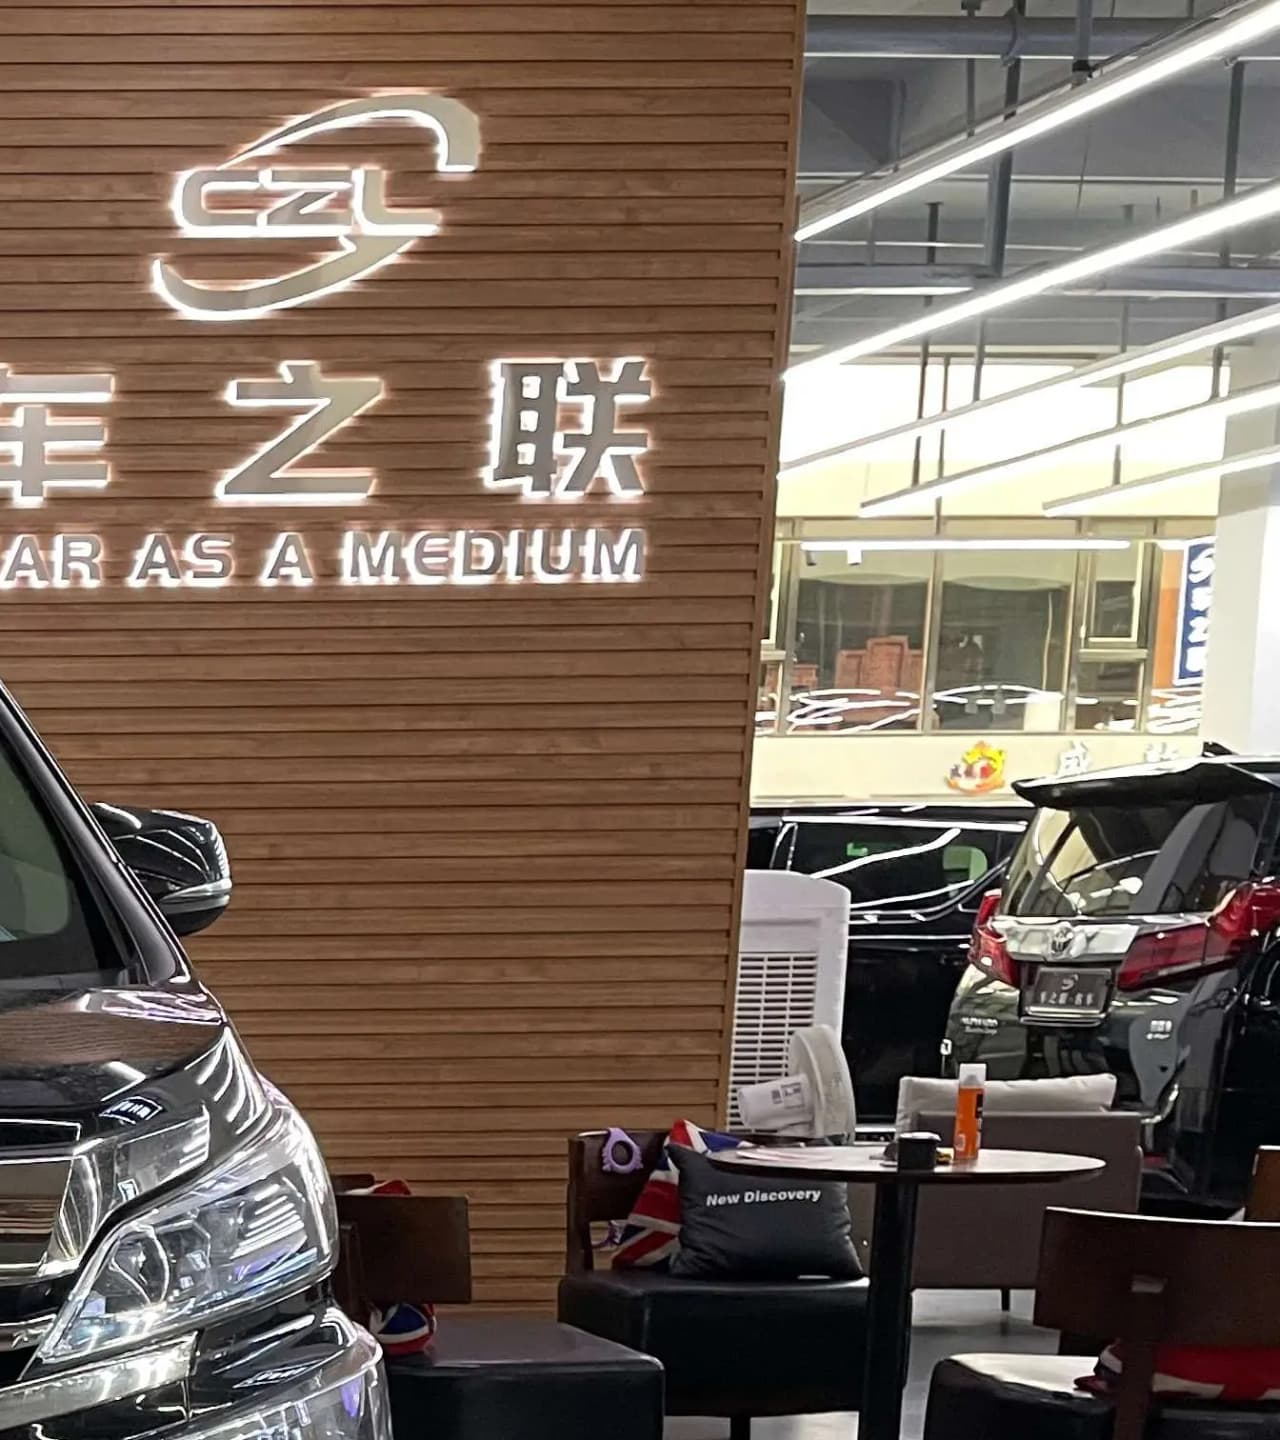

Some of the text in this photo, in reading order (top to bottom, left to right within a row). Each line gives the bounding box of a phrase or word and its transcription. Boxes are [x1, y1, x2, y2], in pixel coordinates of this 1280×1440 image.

[173, 168, 442, 236] CZL
[128, 532, 233, 586] AS
[260, 532, 313, 586] A
[343, 528, 644, 586] MEDIUM
[706, 1190, 821, 1206] New Discovery
